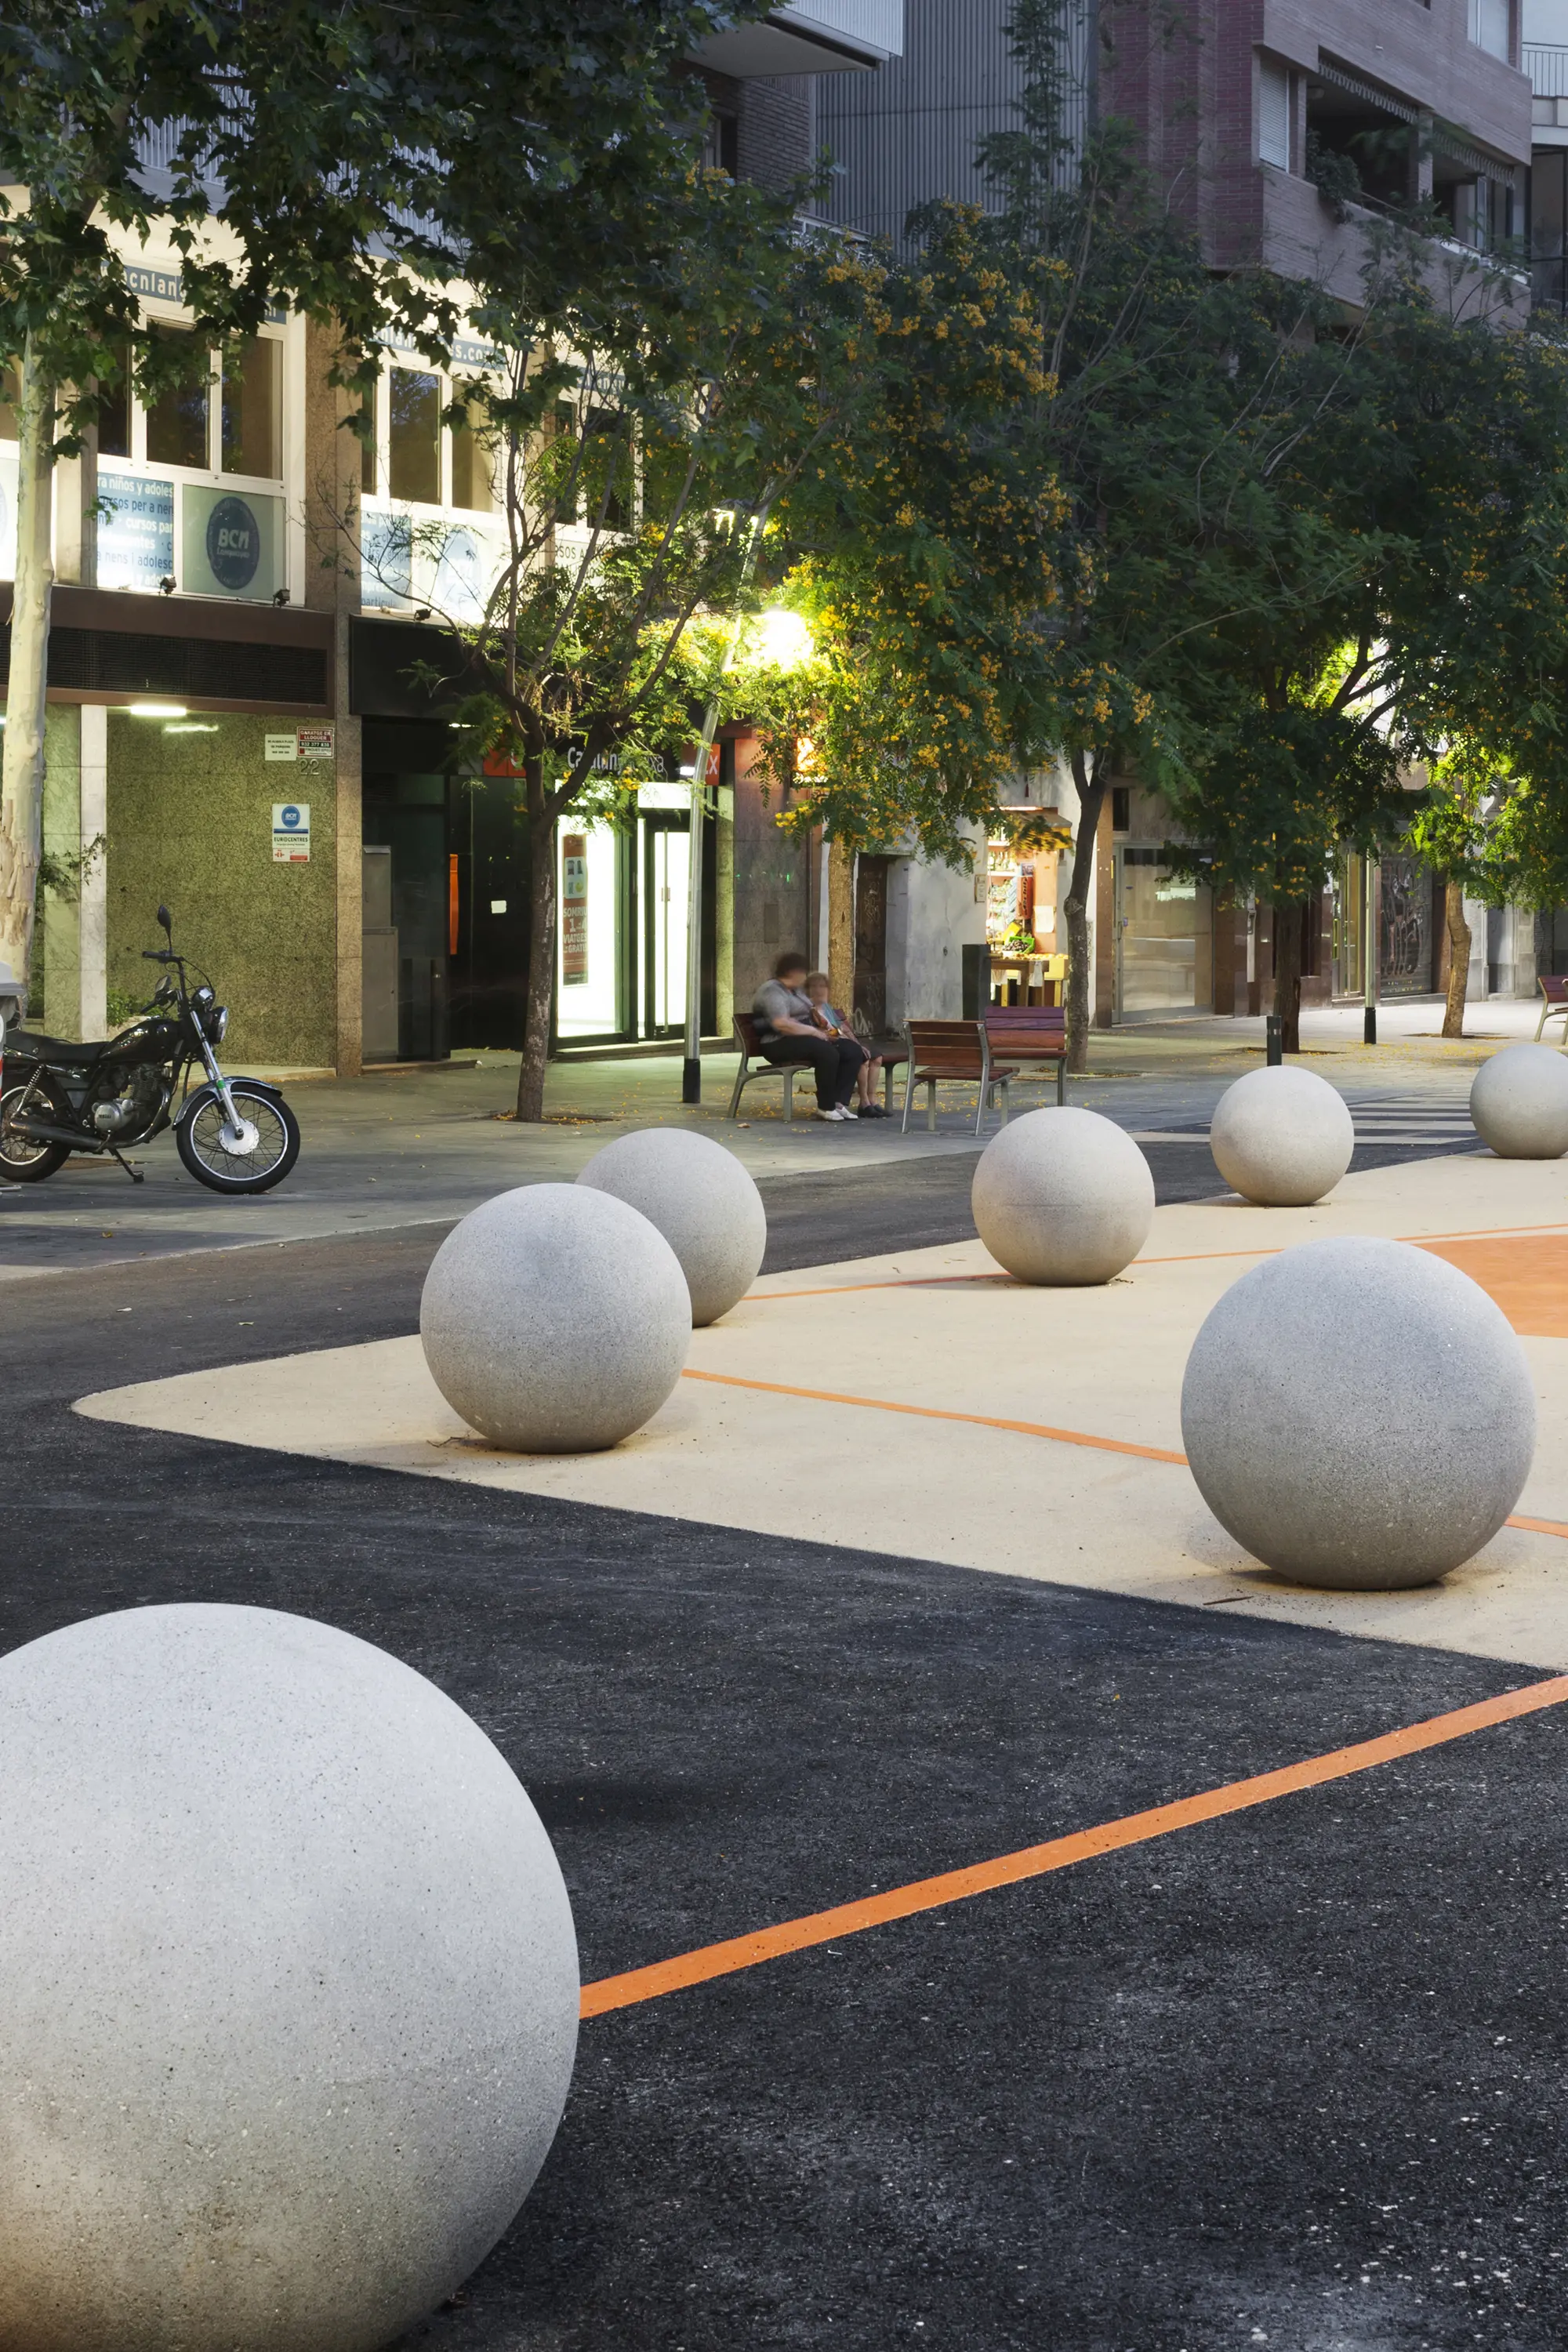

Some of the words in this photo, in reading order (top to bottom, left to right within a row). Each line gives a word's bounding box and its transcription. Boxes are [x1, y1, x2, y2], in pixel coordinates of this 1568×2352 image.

[109, 476, 134, 492] niños
[136, 482, 142, 496] y
[132, 500, 147, 512] per
[149, 503, 155, 513] a
[126, 517, 157, 531] cursos
[105, 552, 128, 564] nens
[138, 554, 173, 570] adolesc
[299, 758, 320, 775] 22
